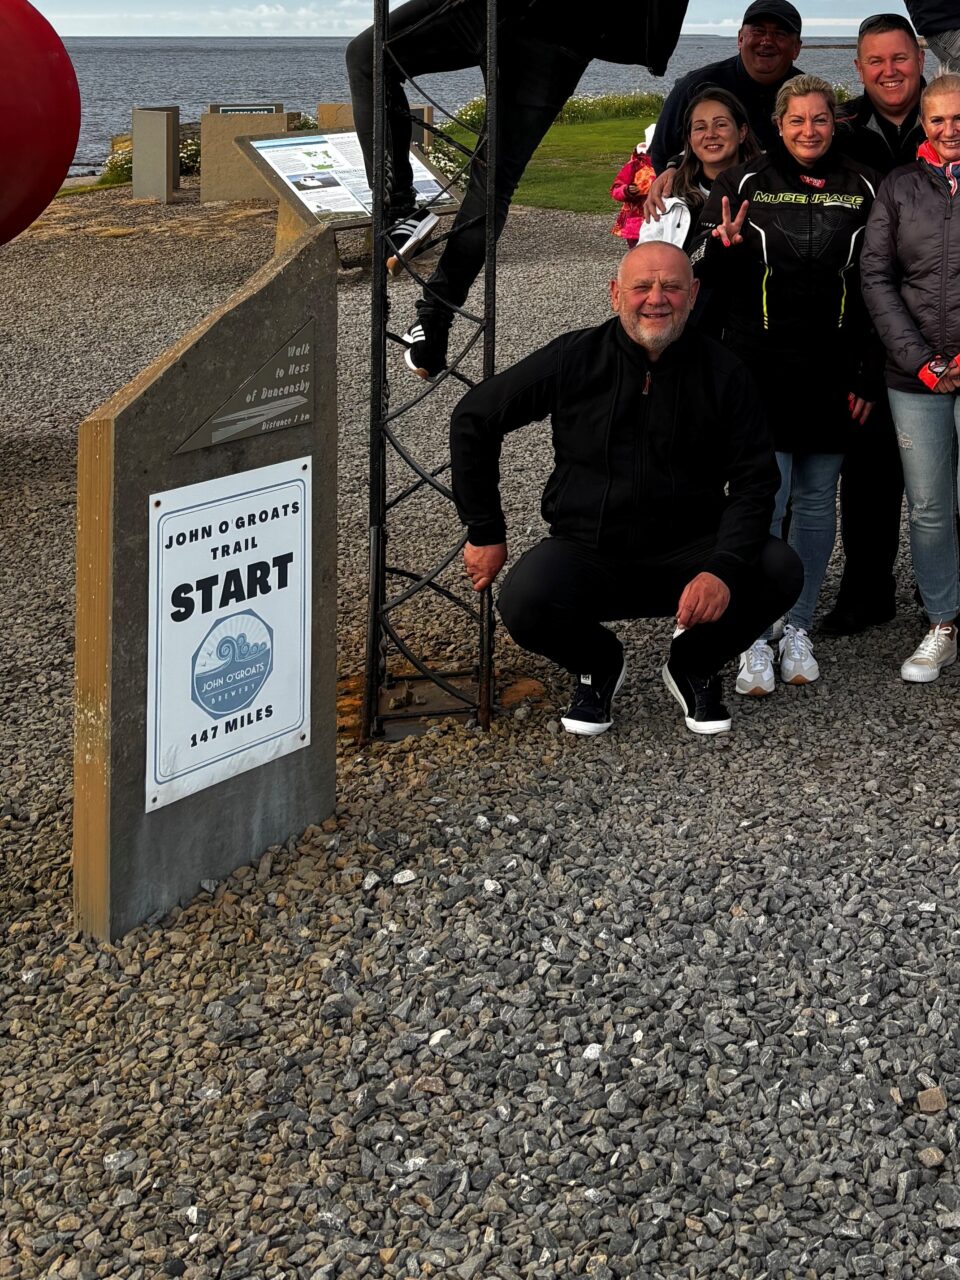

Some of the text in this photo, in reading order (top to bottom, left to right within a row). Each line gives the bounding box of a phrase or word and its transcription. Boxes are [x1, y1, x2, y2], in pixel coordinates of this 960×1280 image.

[753, 190, 865, 205] MUGENRACE
[287, 343, 310, 358] Walk
[275, 363, 310, 379] to Ness
[245, 379, 310, 404] of Duncansby
[261, 418, 293, 431] Distance
[300, 413, 310, 421] km
[165, 501, 300, 550] JOHN O'GROATS
[210, 536, 259, 560] TRAIL
[170, 551, 294, 623] START
[201, 676, 224, 693] JOHN
[211, 683, 256, 705] BREWERY
[190, 704, 274, 748] 147 MILES
